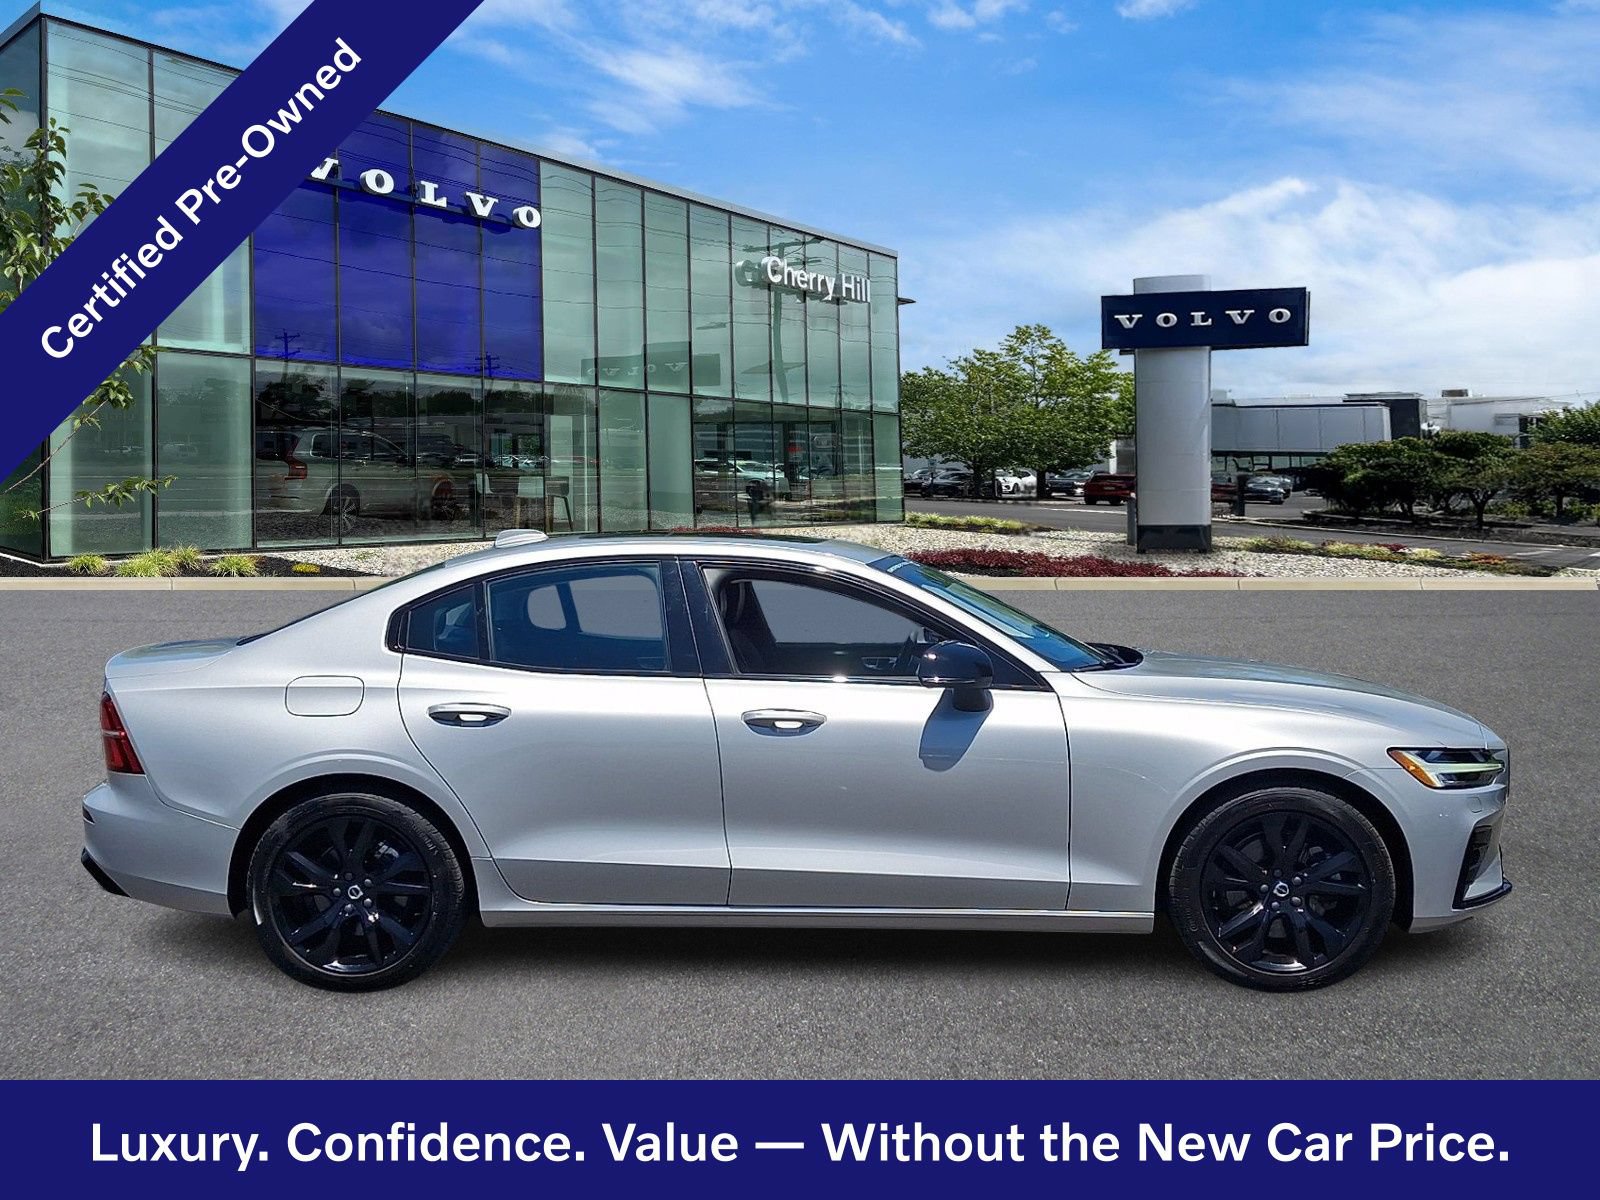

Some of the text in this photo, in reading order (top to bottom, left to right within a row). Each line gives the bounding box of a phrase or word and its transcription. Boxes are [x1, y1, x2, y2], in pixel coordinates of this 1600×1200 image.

[763, 256, 871, 303] Cherry Hill
[1114, 308, 1291, 328] VOLVO
